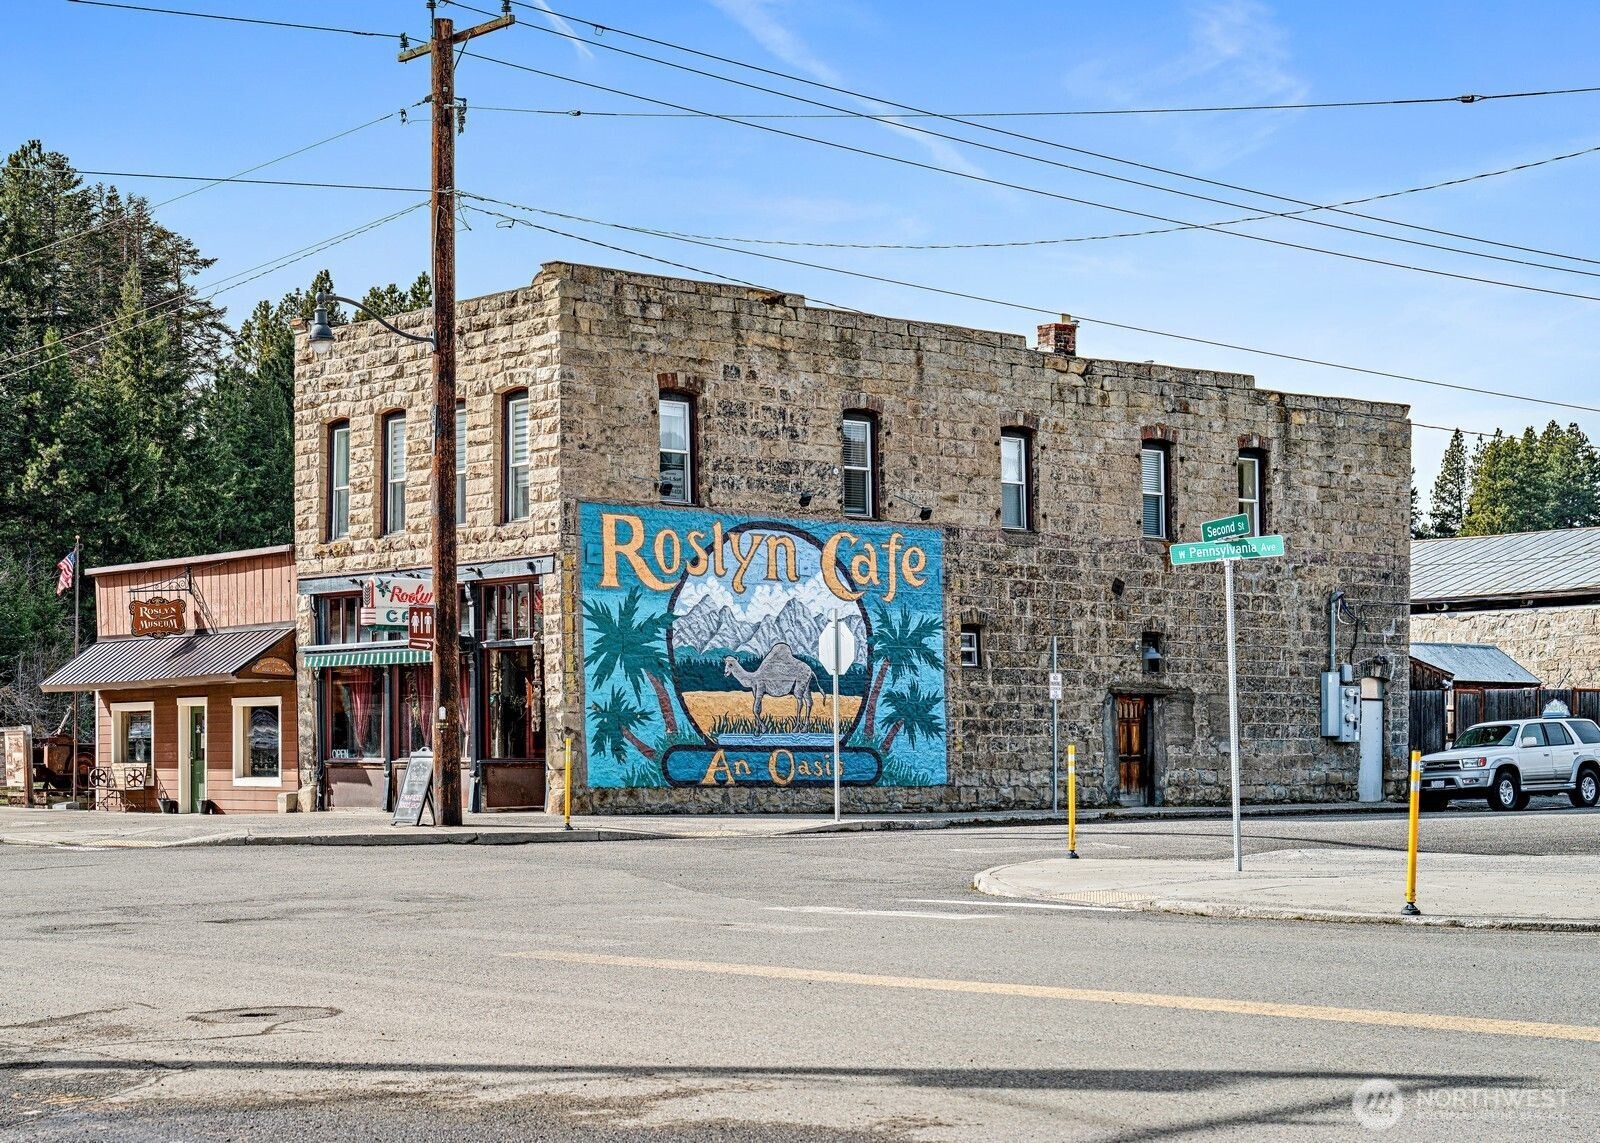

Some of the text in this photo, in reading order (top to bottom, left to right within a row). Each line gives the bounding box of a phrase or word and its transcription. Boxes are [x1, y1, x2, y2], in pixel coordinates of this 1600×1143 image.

[1207, 521, 1245, 538] Second St
[599, 512, 926, 602] Roslyn Cafe
[1178, 543, 1277, 559] W Pennsylvania Ave
[390, 584, 434, 604] Rosly
[139, 606, 177, 620] ROSLYN
[139, 618, 179, 631] MUSEUM
[332, 749, 349, 759] OPEN
[702, 749, 752, 786] An
